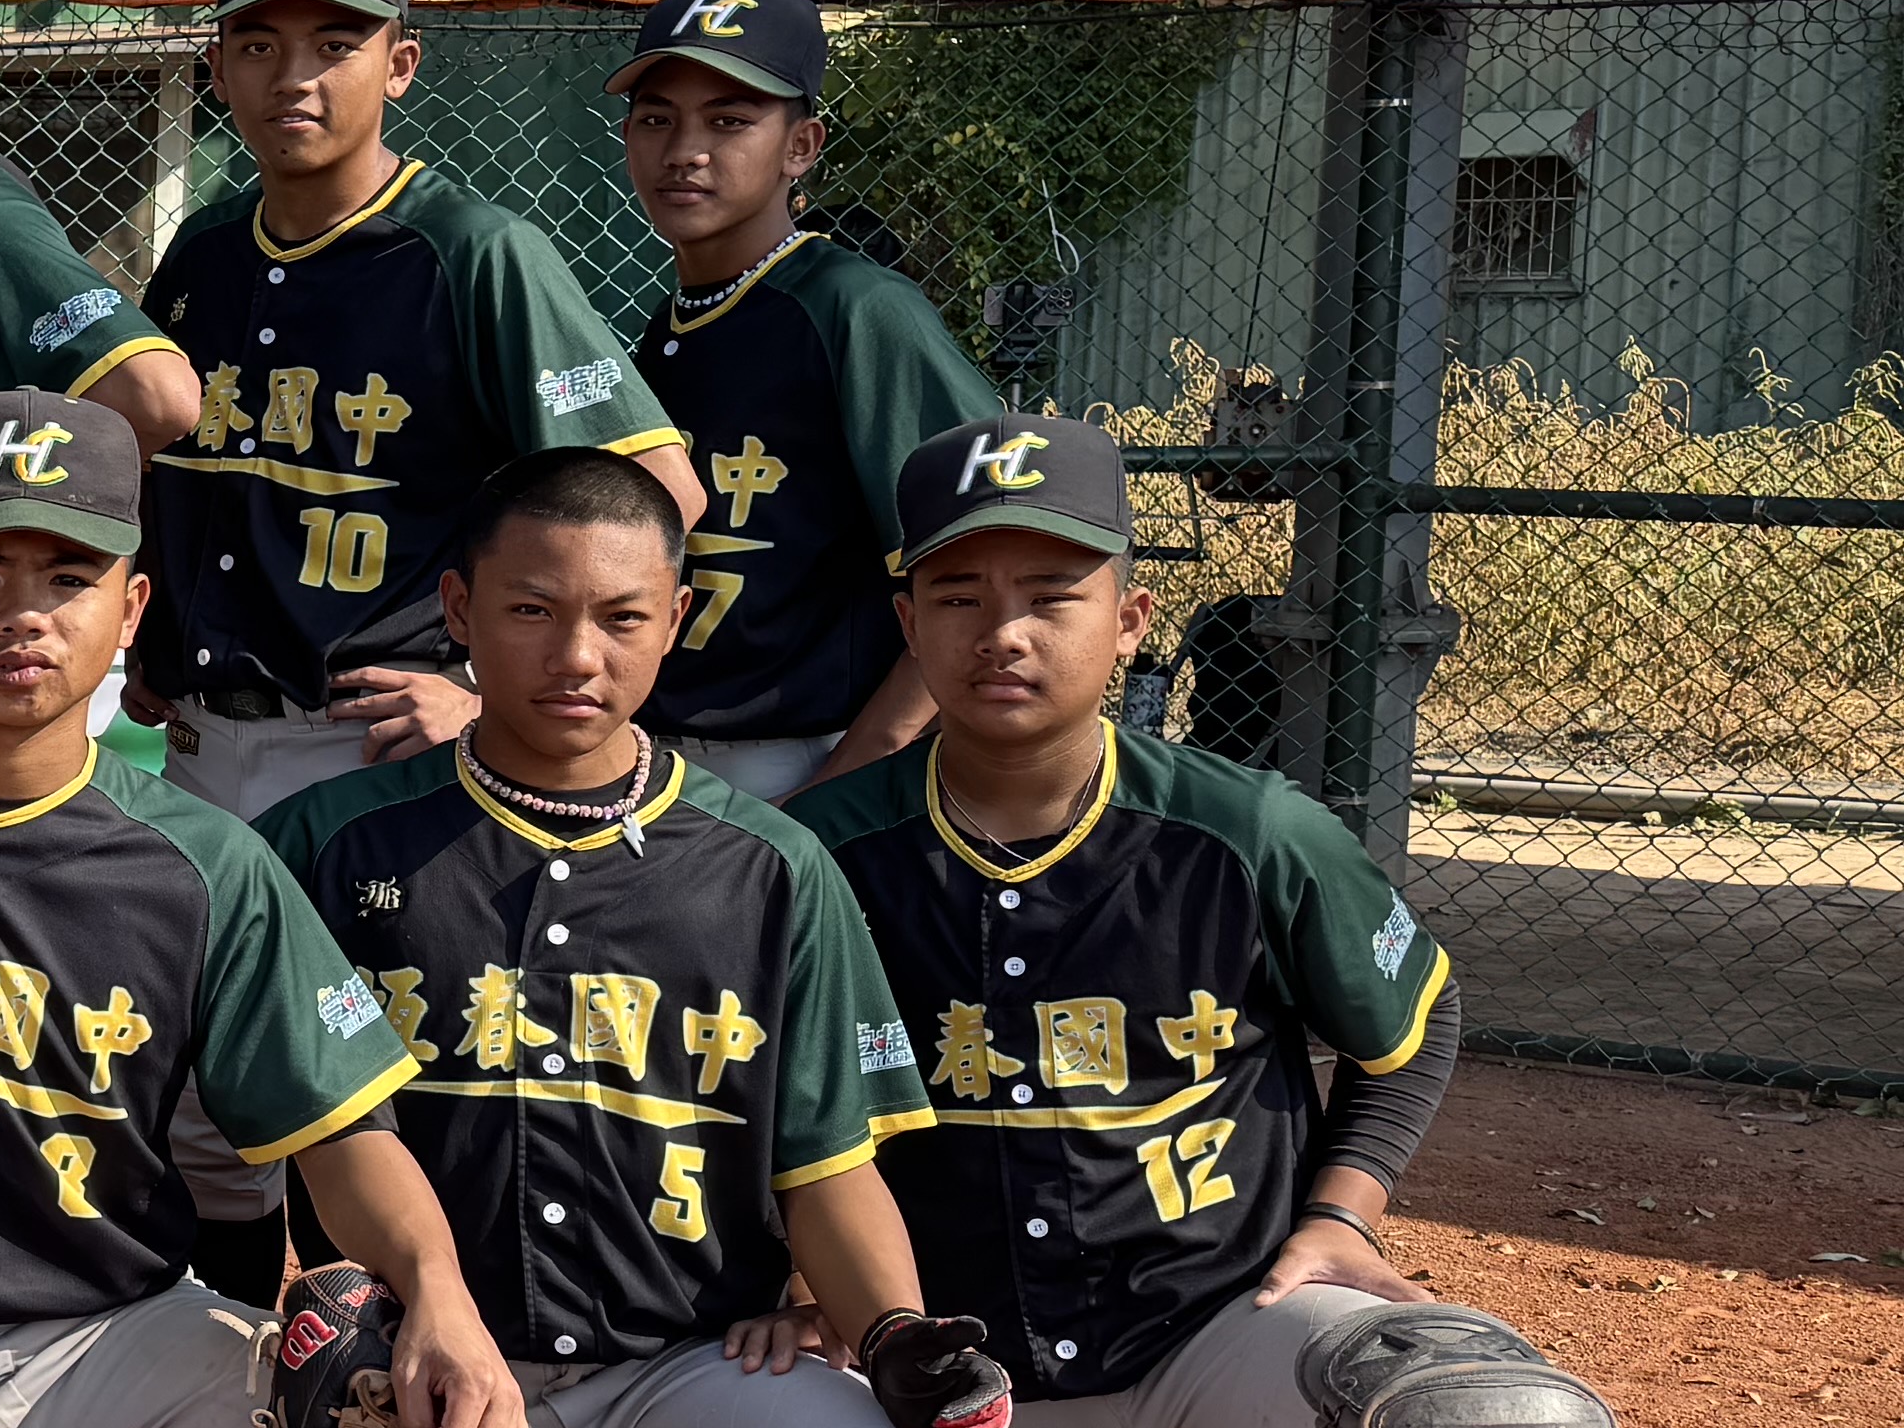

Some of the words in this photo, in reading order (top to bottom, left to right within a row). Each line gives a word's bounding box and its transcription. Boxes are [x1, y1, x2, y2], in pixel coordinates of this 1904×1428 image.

[298, 507, 389, 592] 10
[929, 989, 1238, 1101] 春國中
[649, 1142, 707, 1242] 5
[1137, 1118, 1236, 1222] 12
